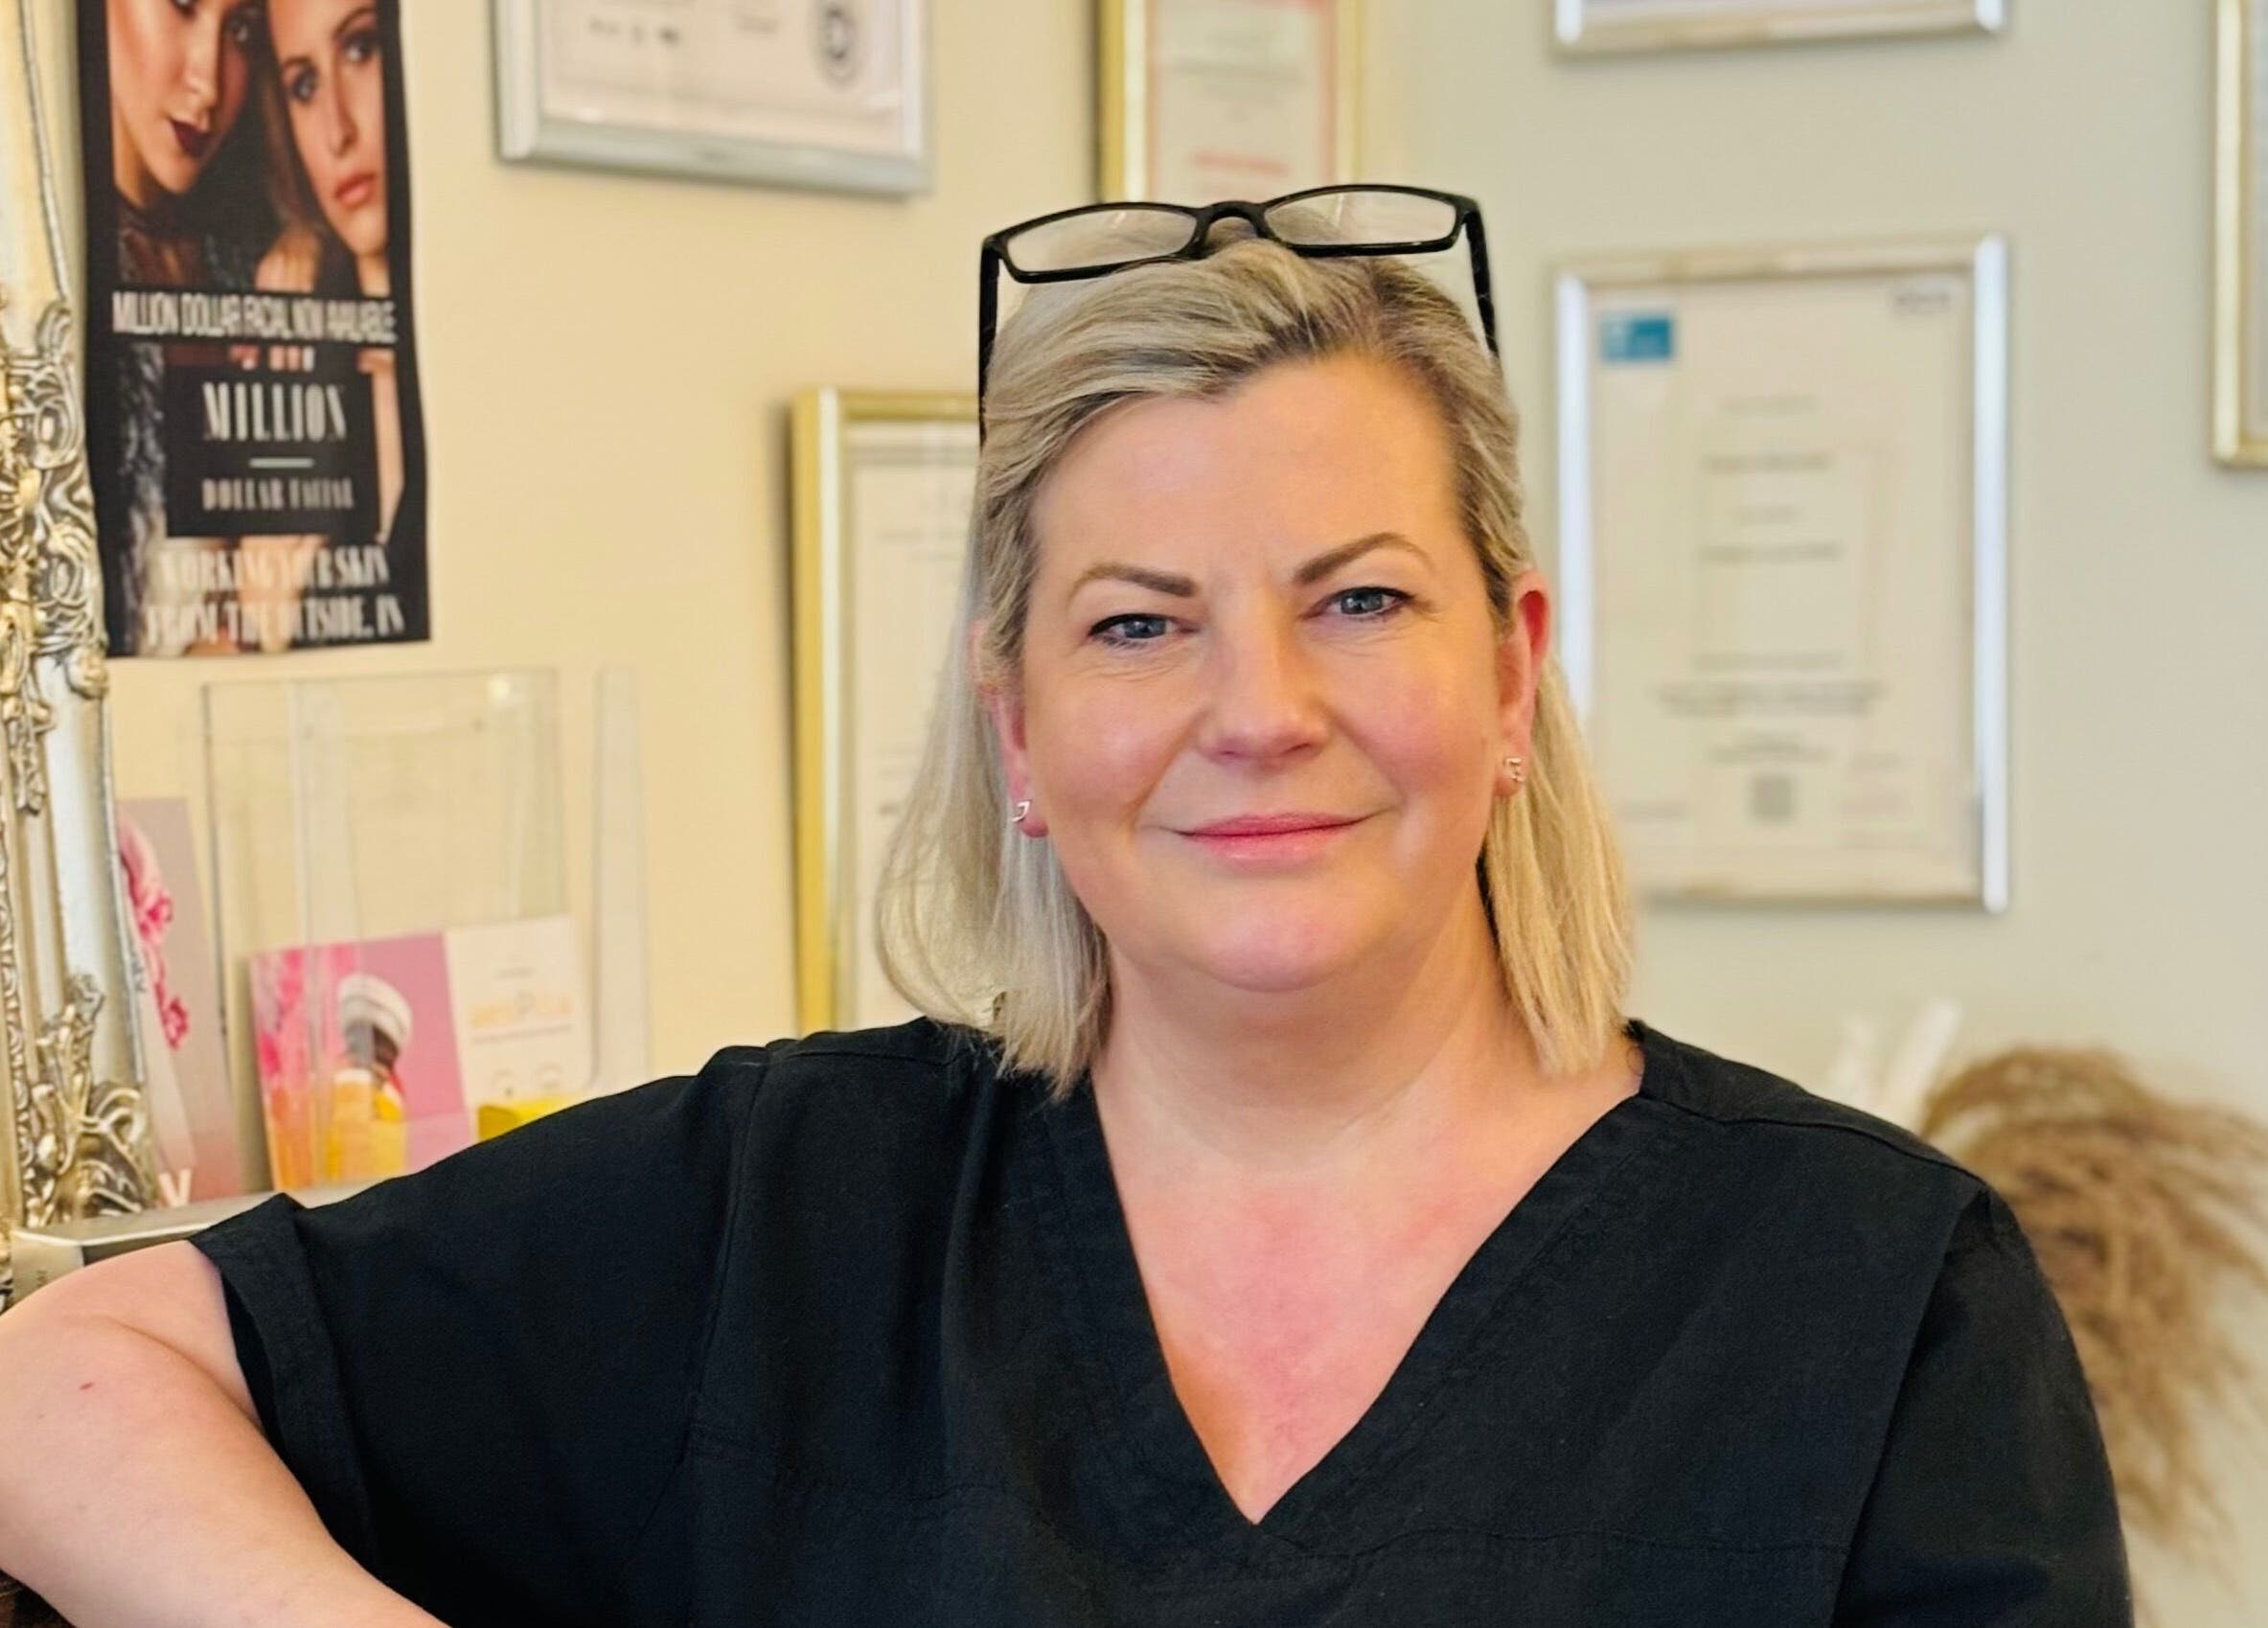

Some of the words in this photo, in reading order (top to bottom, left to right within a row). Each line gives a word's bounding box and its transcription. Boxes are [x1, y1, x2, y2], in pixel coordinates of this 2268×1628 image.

[112, 290, 178, 334] MILLION
[180, 292, 241, 337] DOLLAR
[202, 381, 347, 443] MILLION
[202, 478, 285, 511] DOLLAR
[335, 544, 391, 588] SKIN
[377, 593, 404, 638] IN
